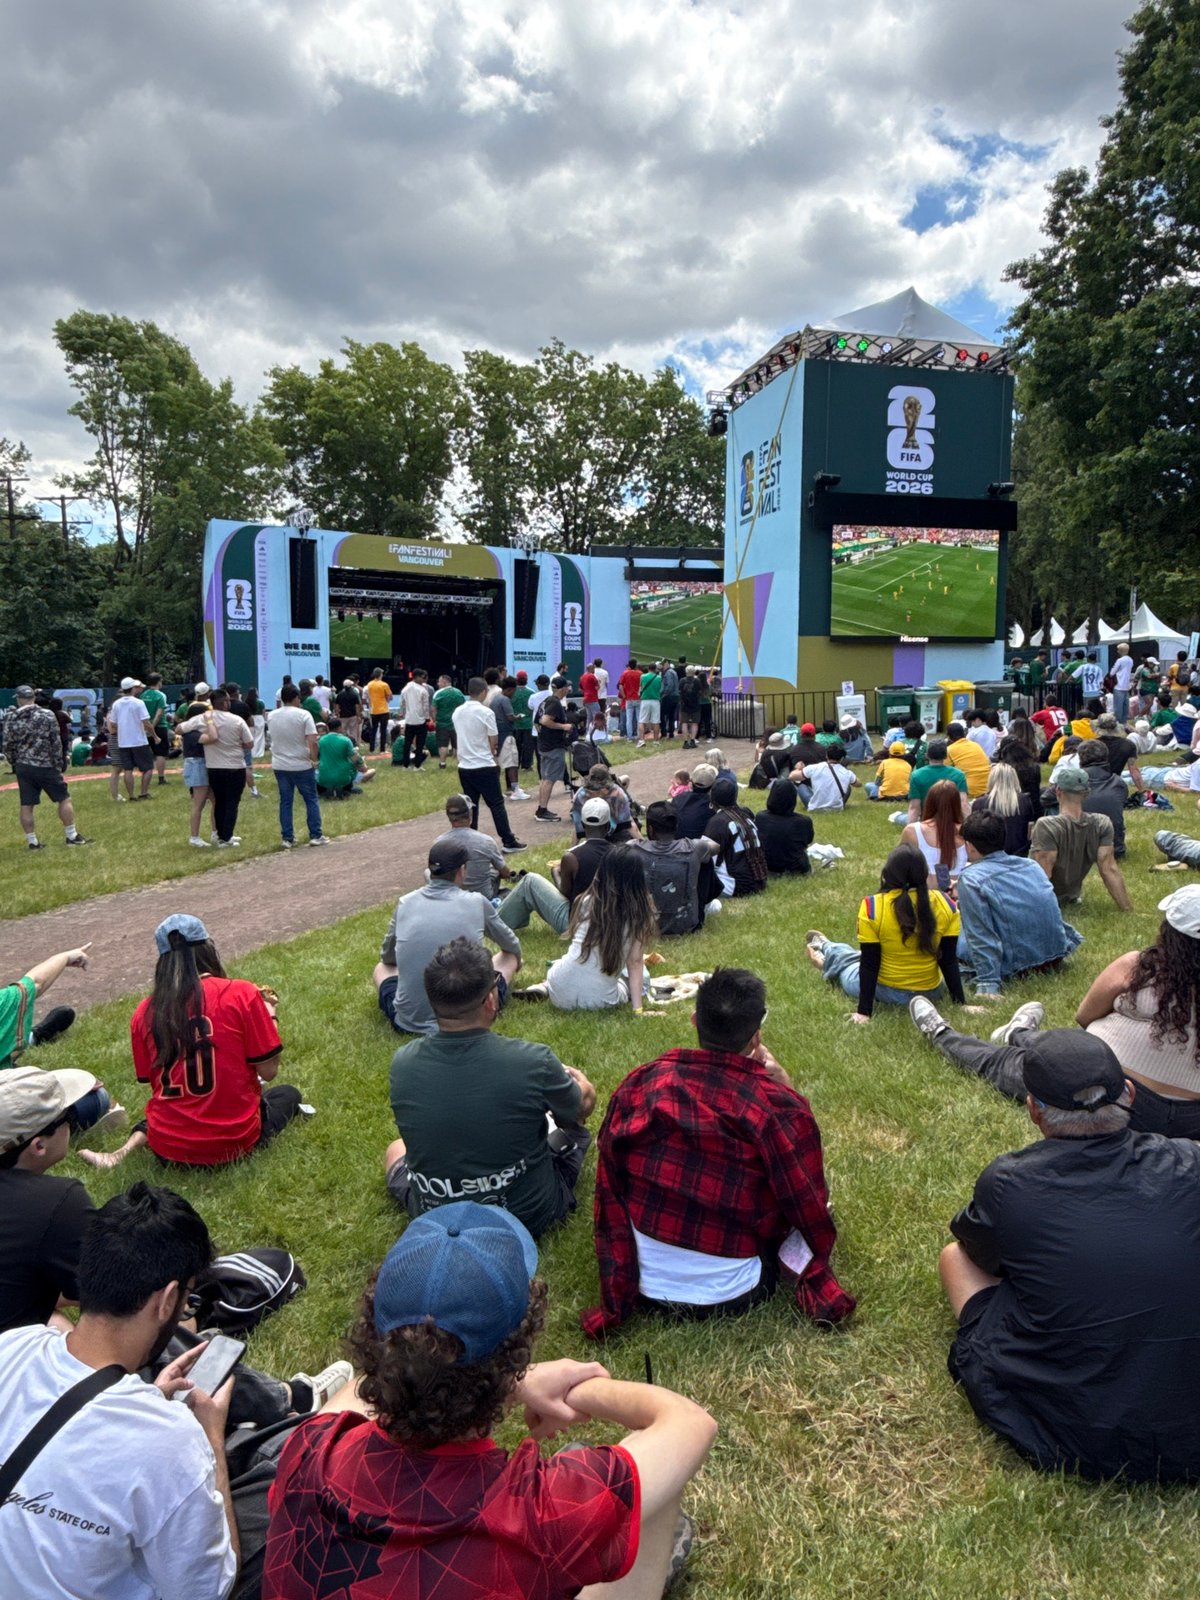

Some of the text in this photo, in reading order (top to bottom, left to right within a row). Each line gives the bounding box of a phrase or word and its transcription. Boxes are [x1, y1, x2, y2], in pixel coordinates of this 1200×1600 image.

[900, 453, 922, 462] FIFA
[886, 472, 934, 481] WORLD CUP
[885, 480, 933, 495] 2026
[398, 555, 444, 566] VANCOUVER
[900, 635, 929, 643] Hisense
[1084, 673, 1095, 684] 19
[1049, 711, 1068, 726] 19
[49, 1508, 81, 1527] STATE
[80, 1520, 96, 1532] OF
[95, 1526, 111, 1536] CA
